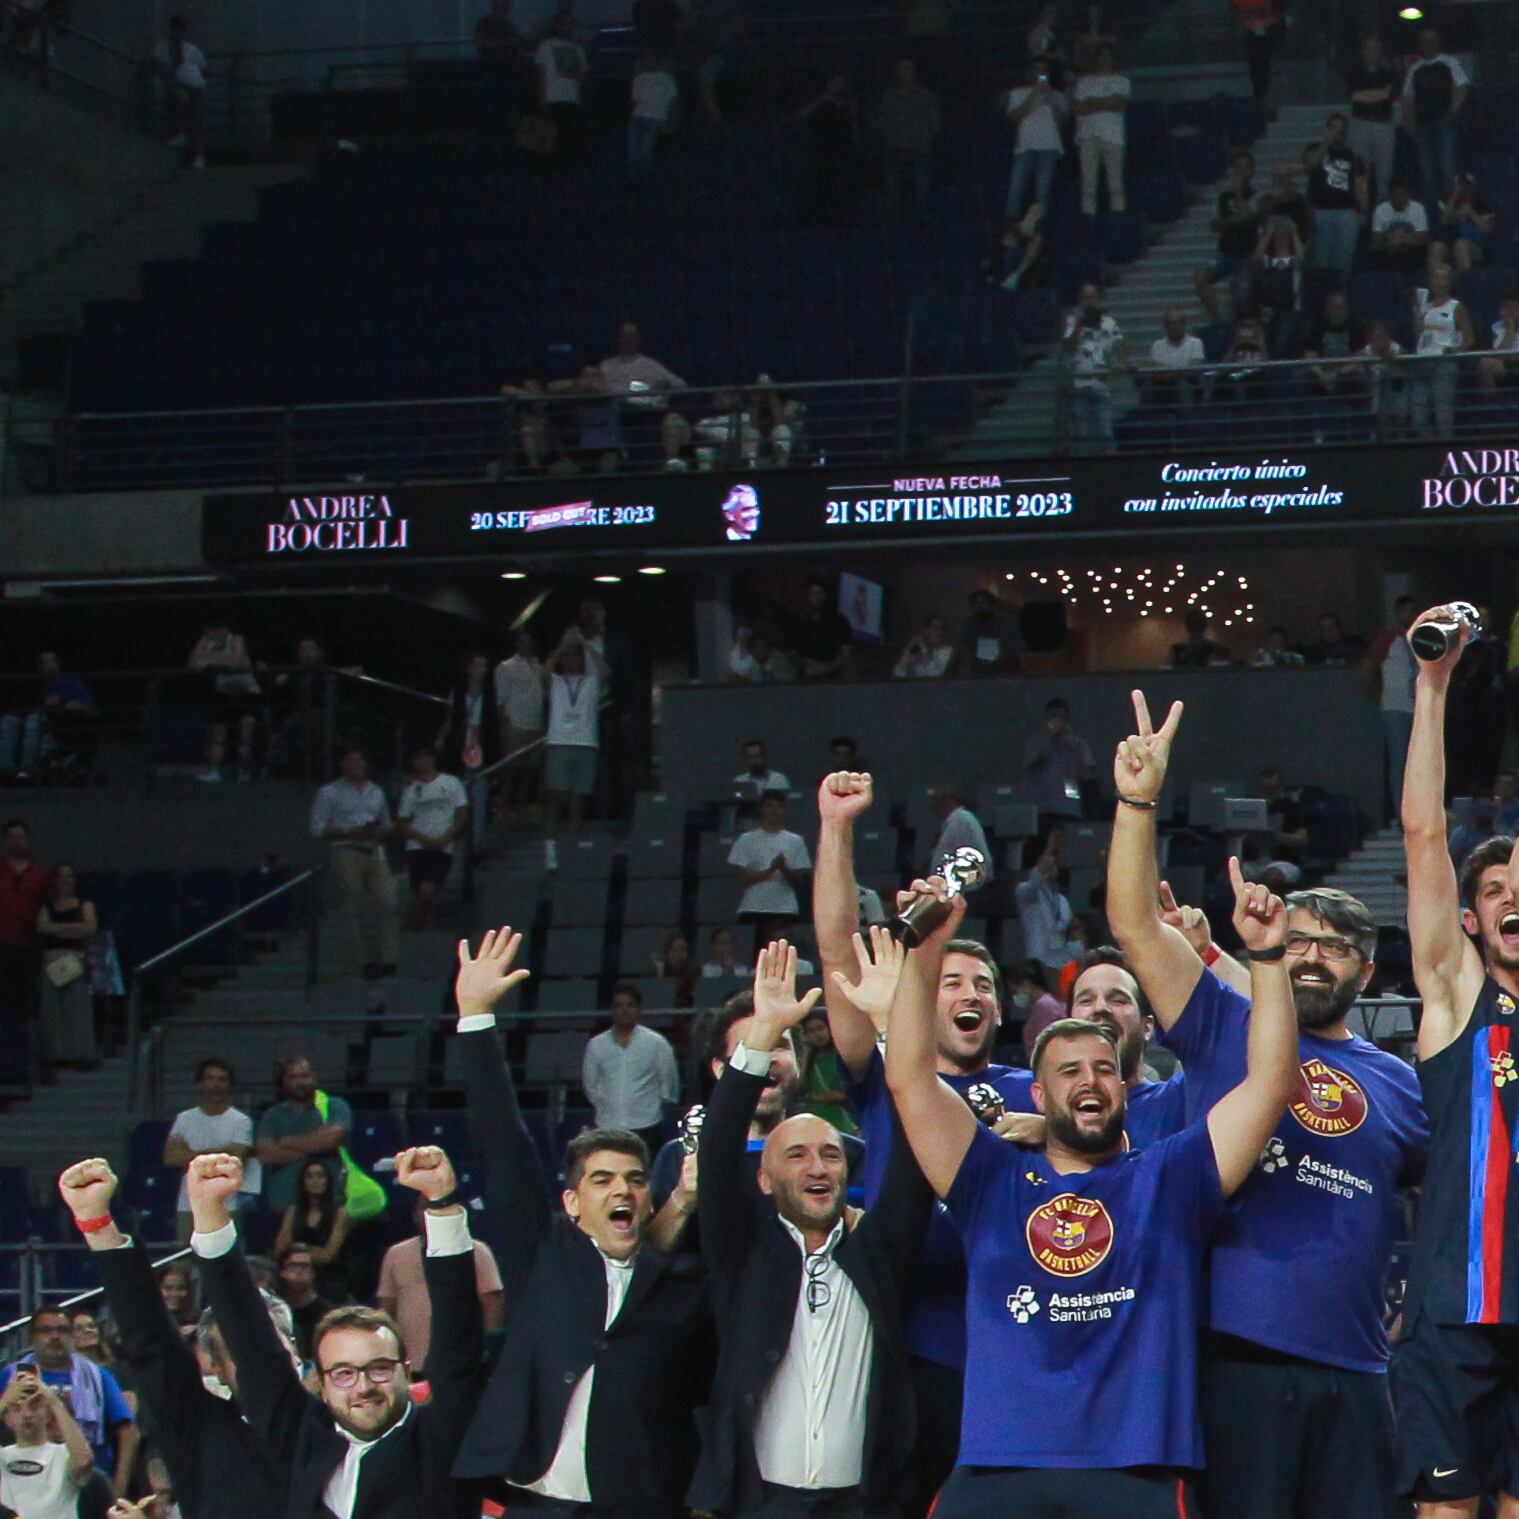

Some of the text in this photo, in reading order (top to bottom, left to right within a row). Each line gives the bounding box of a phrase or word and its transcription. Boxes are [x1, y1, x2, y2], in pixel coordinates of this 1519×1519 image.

[894, 475, 1001, 492] NUEVA FECHA
[1161, 461, 1306, 483] Concierto único
[287, 495, 393, 521] ANDREA
[826, 493, 1072, 524] 21 SEPTIEMBRE 2023
[1124, 485, 1342, 515] con invitados especiales
[471, 513, 493, 529] 20
[613, 506, 655, 526] 2023
[267, 519, 408, 552] BOCELLI
[1294, 1102, 1351, 1132] BASKETBALL
[1039, 1248, 1100, 1271] BASKETBALL
